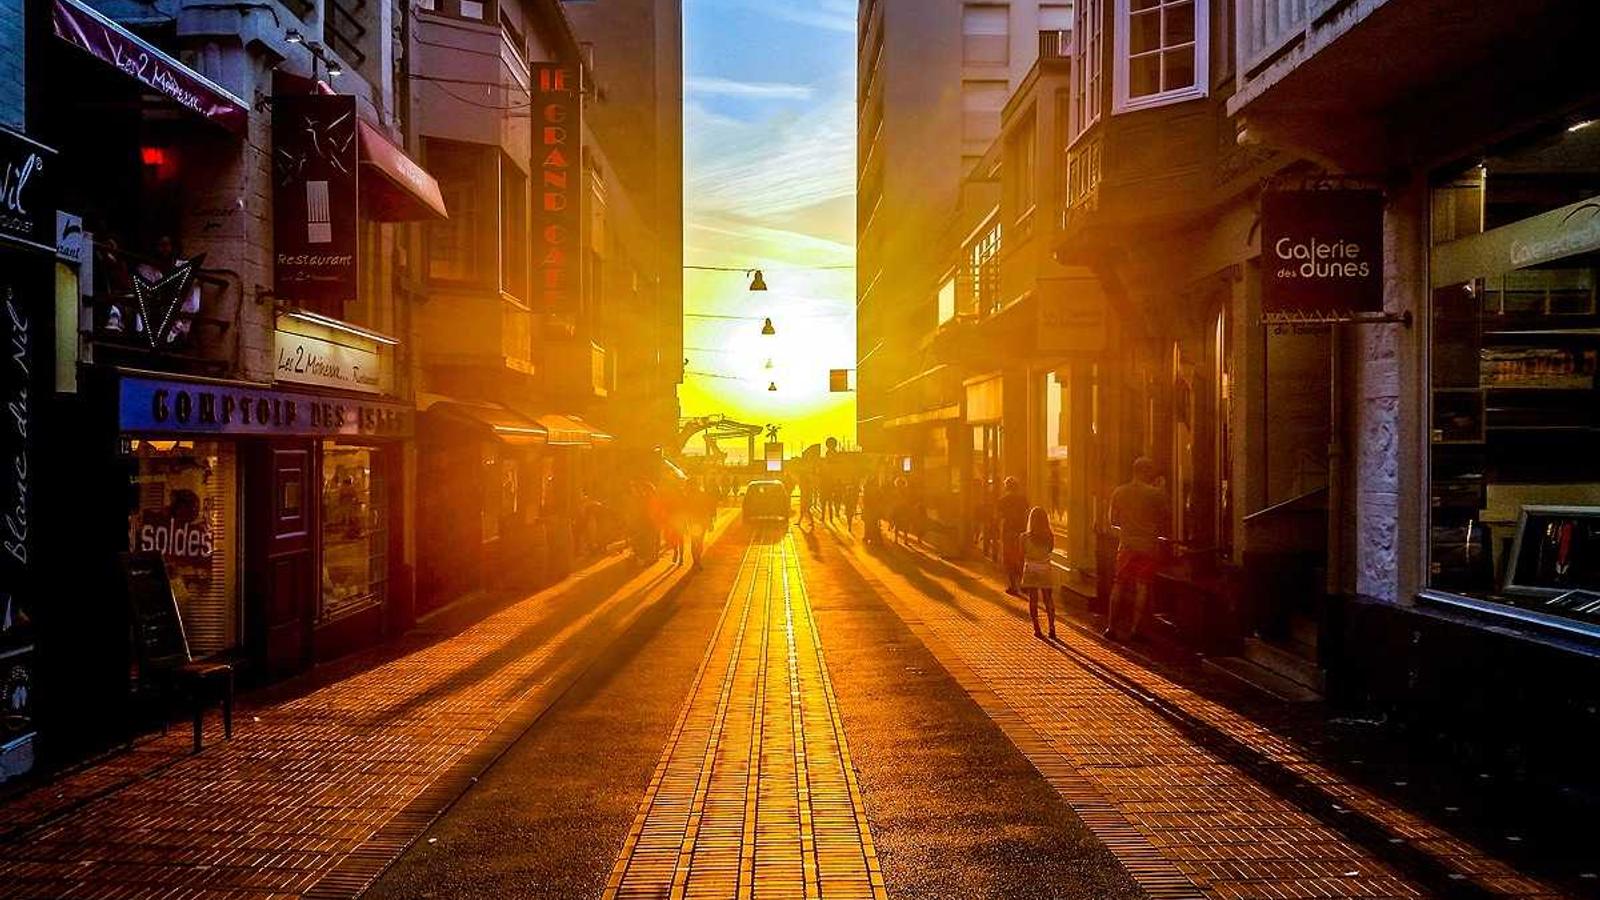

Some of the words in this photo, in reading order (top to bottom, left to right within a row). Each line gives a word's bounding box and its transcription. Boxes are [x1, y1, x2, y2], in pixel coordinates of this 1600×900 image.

[137, 53, 149, 84] 2
[543, 103, 568, 211] GRAND
[278, 254, 353, 266] Restaurant
[1276, 236, 1360, 259] Galerie
[1277, 266, 1297, 278] des
[1300, 260, 1370, 278] dunes
[6, 299, 29, 375] Nil
[295, 345, 304, 374] 2
[8, 387, 28, 439] du
[310, 401, 346, 428] DES
[4, 450, 28, 565] Blanc
[141, 518, 213, 558] soldes
